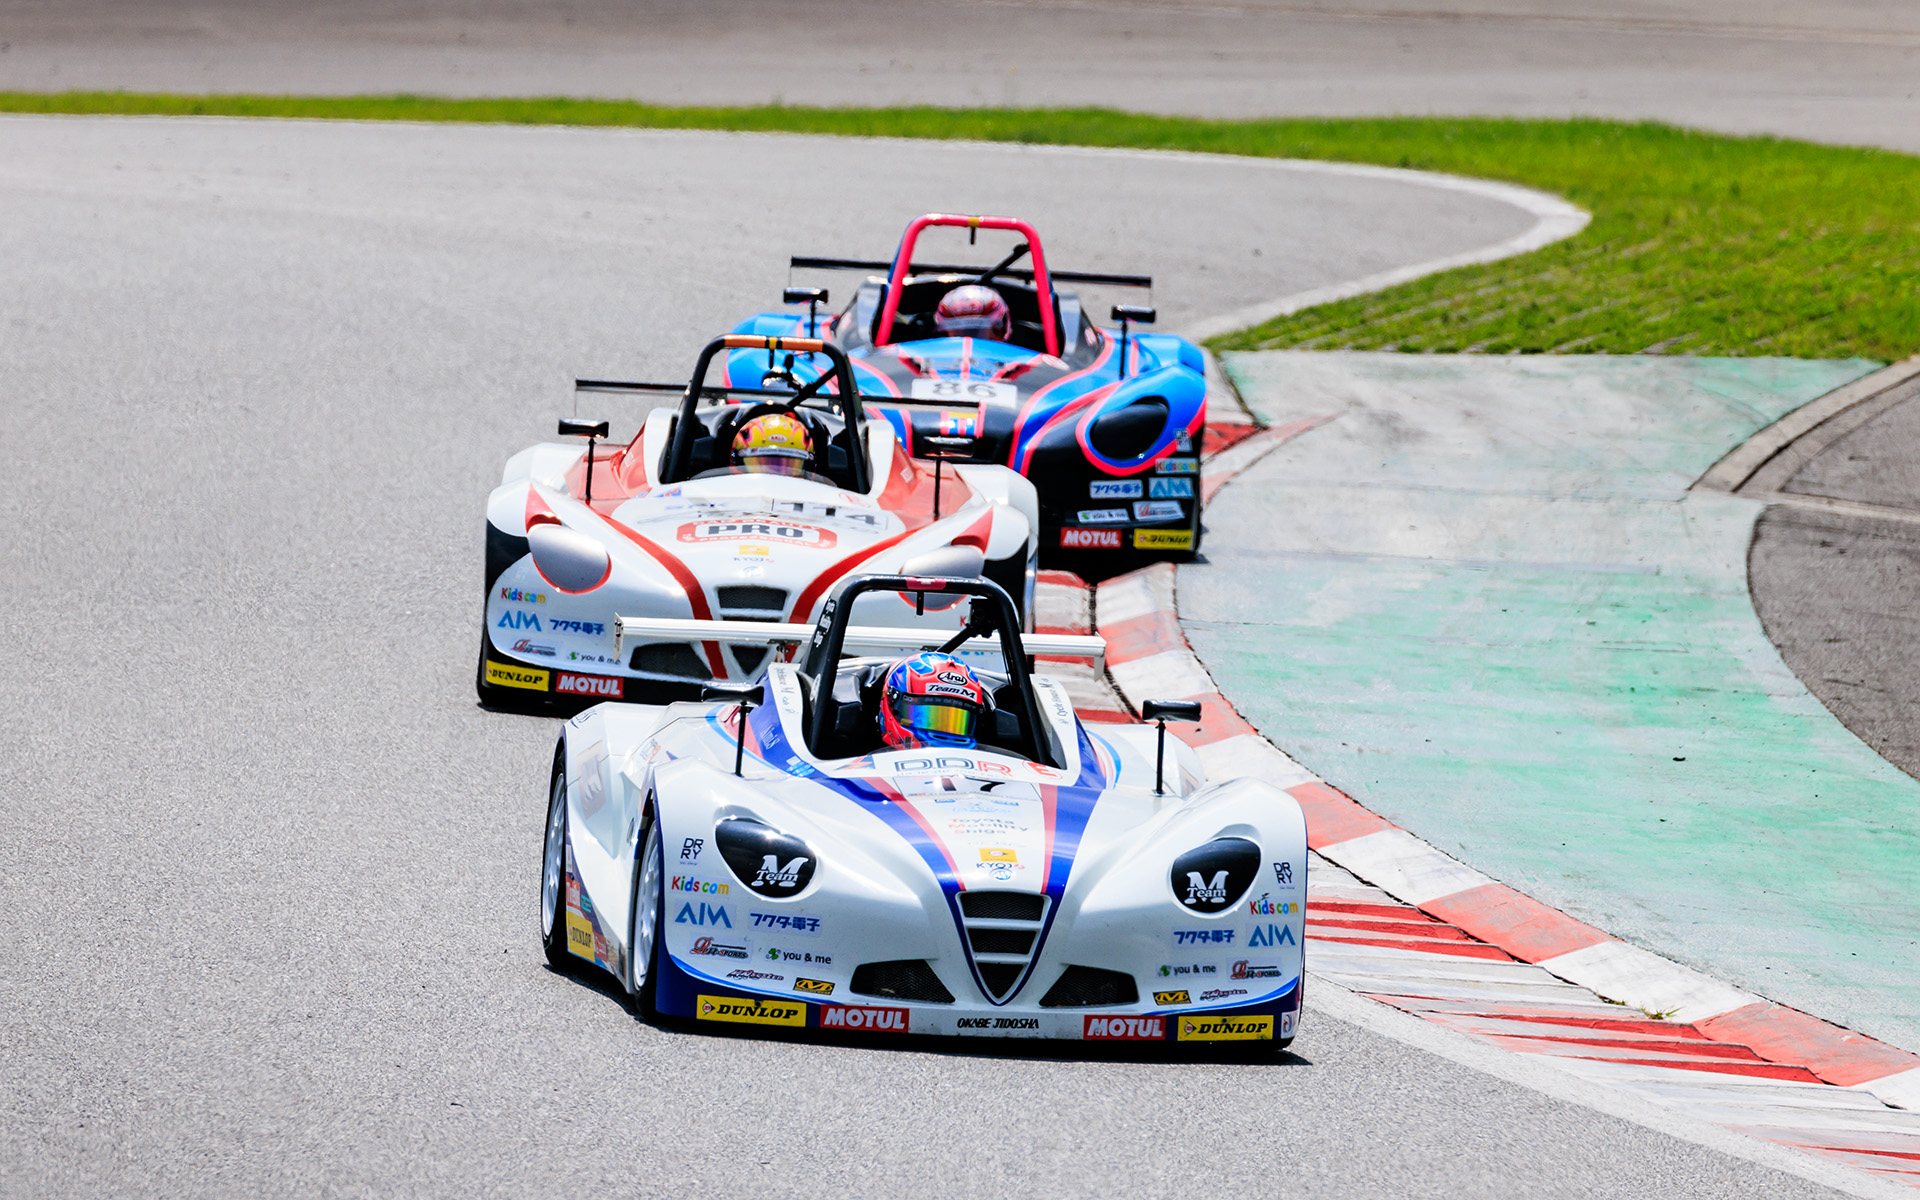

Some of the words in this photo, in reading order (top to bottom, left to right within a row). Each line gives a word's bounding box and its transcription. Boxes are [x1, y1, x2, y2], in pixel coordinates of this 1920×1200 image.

[932, 382, 997, 398] 86
[780, 501, 885, 527] 114
[708, 524, 804, 538] PRO
[1063, 530, 1120, 545] MOTUL
[698, 534, 815, 547] PROFESSIONAL
[501, 587, 523, 602] Kids
[524, 592, 546, 604] com
[497, 610, 542, 632] AIM
[581, 653, 596, 662] you
[492, 668, 544, 684] DUNLOP
[942, 671, 965, 683] Arai
[558, 675, 621, 696] MOTUL
[928, 684, 961, 694] Team
[961, 689, 976, 699] M
[924, 775, 1006, 793] 17
[683, 837, 704, 850] DR
[680, 848, 702, 860] RY
[755, 869, 799, 882] Team
[1273, 862, 1292, 874] DR
[671, 875, 700, 893] Kids
[701, 881, 730, 896] com
[1276, 872, 1293, 884] RY
[1186, 887, 1227, 898] Team
[674, 901, 733, 929] AIM
[1249, 900, 1275, 915] Kids
[1276, 901, 1299, 915] com
[1248, 923, 1296, 947] AIM
[783, 951, 801, 962] you
[804, 952, 812, 962] &
[814, 955, 832, 964] me
[1173, 964, 1191, 976] you
[1193, 964, 1200, 974] &
[1202, 965, 1217, 973] me
[716, 1003, 799, 1020] DUNLOP
[823, 1007, 906, 1030] MOTUL
[956, 1017, 992, 1029] OKABE
[993, 1017, 1040, 1029] JIDOSHA
[1087, 1017, 1165, 1038] MOTUL
[1197, 1022, 1269, 1034] DUNLOP
